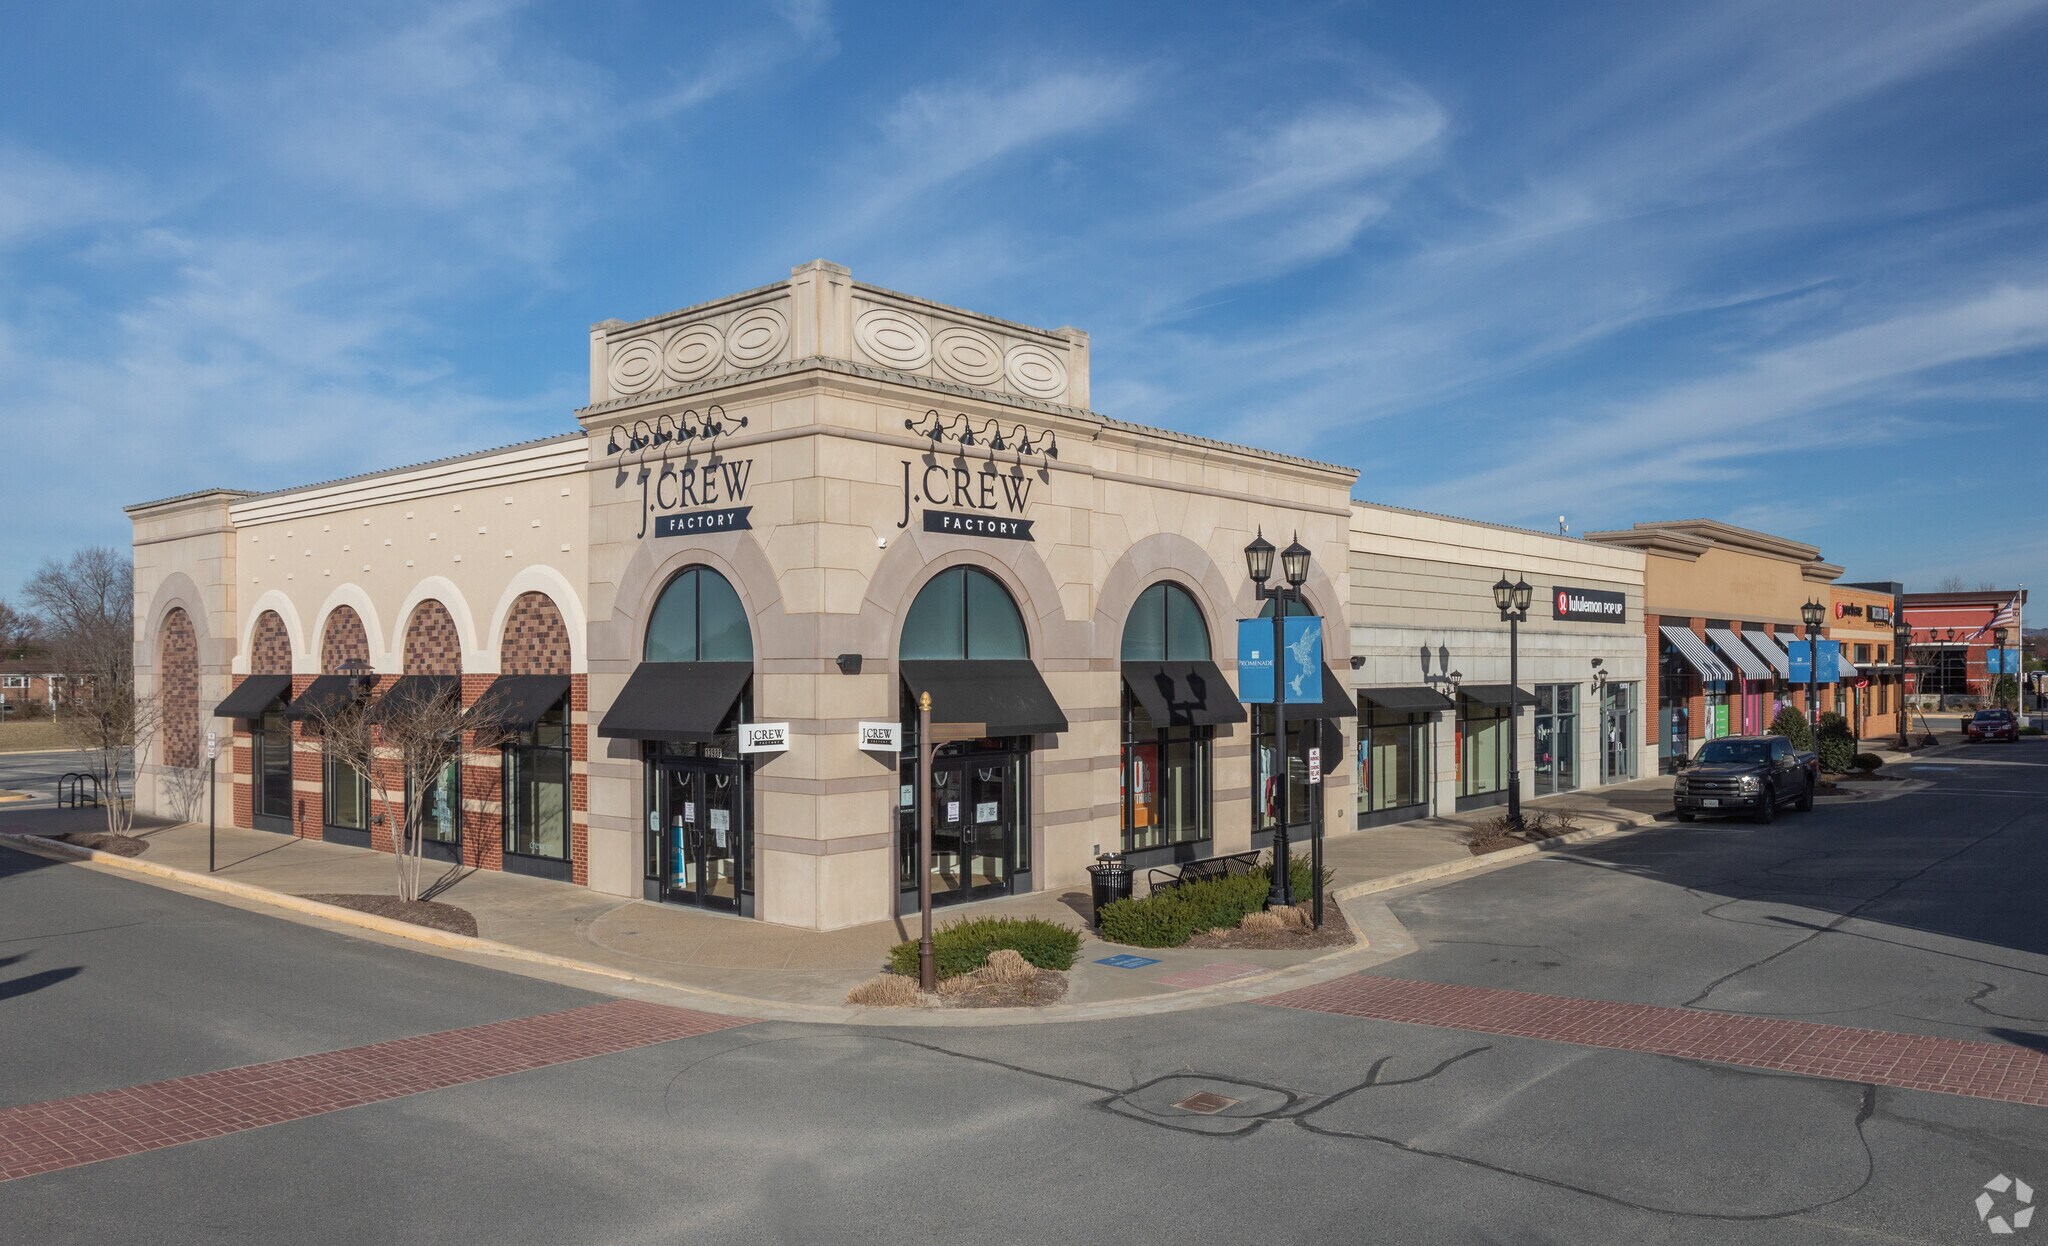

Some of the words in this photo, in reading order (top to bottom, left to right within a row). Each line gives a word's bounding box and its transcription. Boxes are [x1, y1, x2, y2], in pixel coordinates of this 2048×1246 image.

[637, 459, 754, 539] J.CREW
[897, 460, 1033, 528] J.CREW
[670, 513, 735, 531] FACTORY
[943, 516, 1018, 534] FACTORY
[1568, 594, 1603, 614] lululemon
[1603, 602, 1615, 614] POP
[1615, 603, 1623, 615] UP
[1239, 659, 1274, 667] PROMENADE
[747, 728, 785, 747] J.CREW
[861, 727, 892, 744] J.CREW
